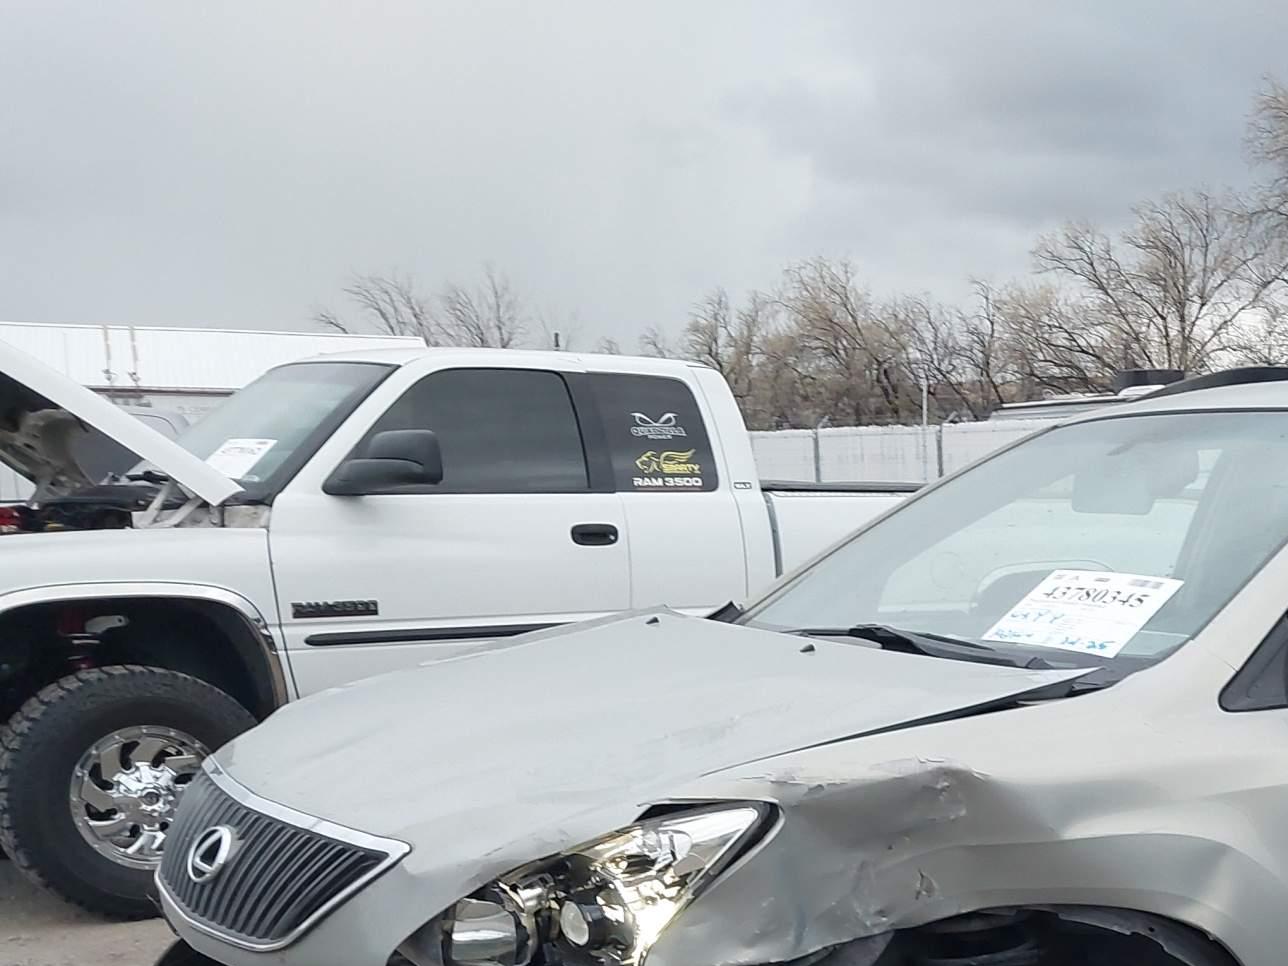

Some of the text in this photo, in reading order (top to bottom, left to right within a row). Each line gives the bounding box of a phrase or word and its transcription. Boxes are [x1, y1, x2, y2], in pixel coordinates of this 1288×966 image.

[632, 477, 703, 487] RAM 3500
[1043, 585, 1151, 608] 43780345
